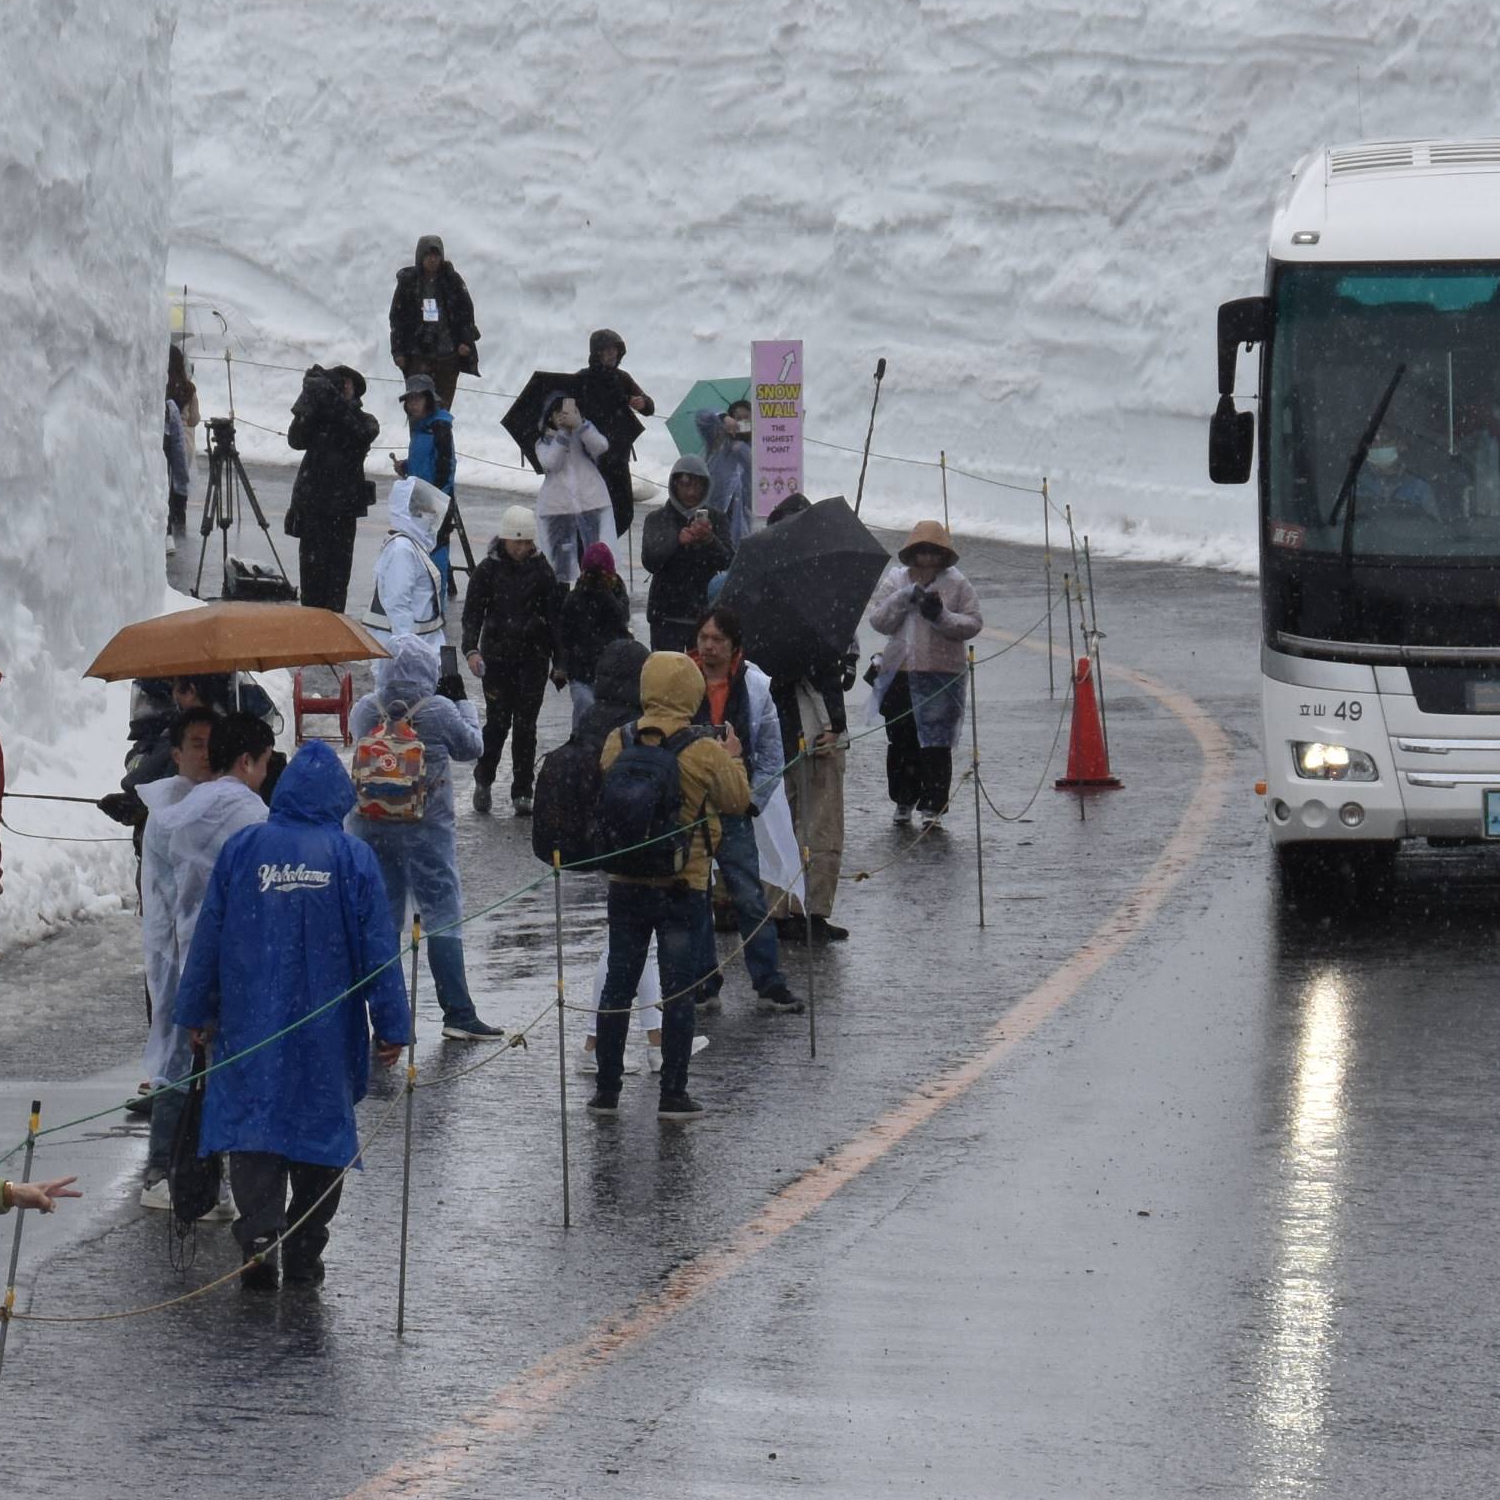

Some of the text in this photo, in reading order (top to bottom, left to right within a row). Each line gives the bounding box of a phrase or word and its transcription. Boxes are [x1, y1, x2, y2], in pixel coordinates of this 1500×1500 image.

[756, 384, 801, 400] SNOW
[759, 401, 798, 418] WALL
[772, 424, 786, 432] THE
[762, 435, 794, 443] HIGHEST
[1300, 700, 1362, 721] 立山 49
[258, 862, 332, 892] Yokohama
